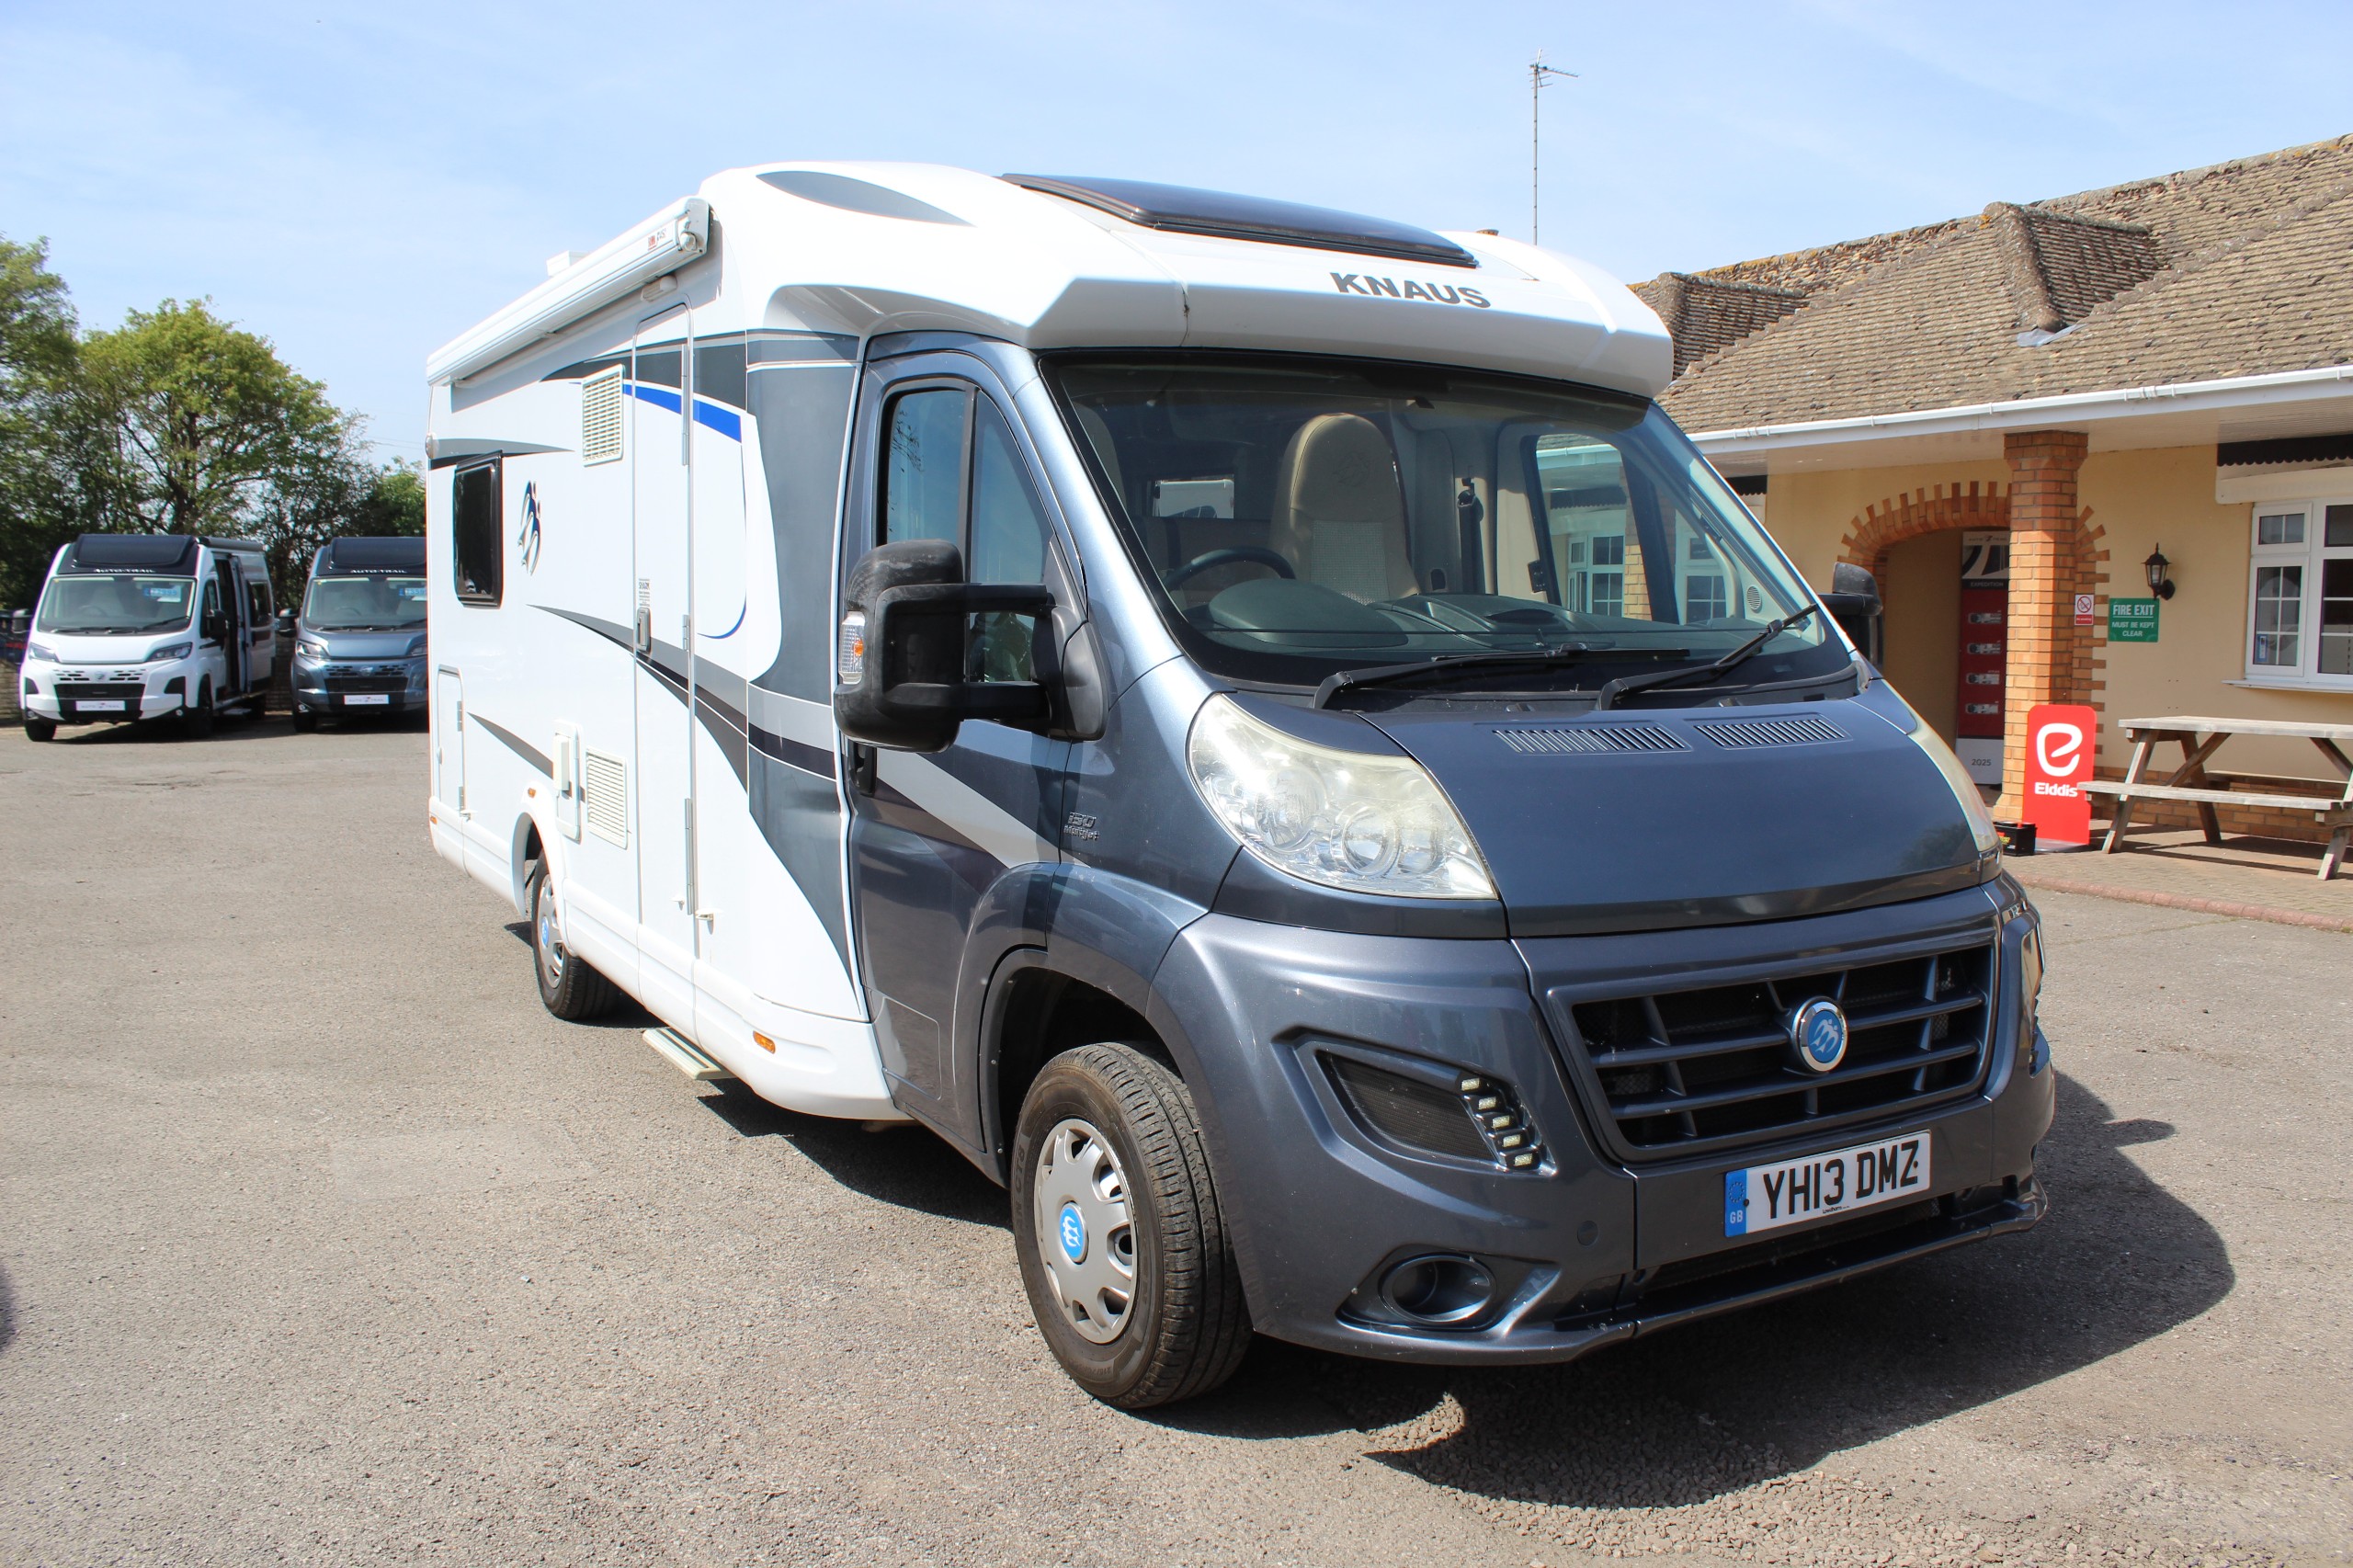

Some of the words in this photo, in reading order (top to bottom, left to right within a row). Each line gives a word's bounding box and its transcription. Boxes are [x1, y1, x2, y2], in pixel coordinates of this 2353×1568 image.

[1329, 272, 1491, 309] KNAUS
[2112, 604, 2132, 616] FIRE
[2133, 604, 2155, 616] EXIT
[1971, 758, 1992, 767] 2025
[2034, 781, 2078, 798] Elddis
[1763, 1158, 1845, 1220] YH13
[1856, 1139, 1919, 1199] DMZ
[1730, 1209, 1744, 1224] GB
